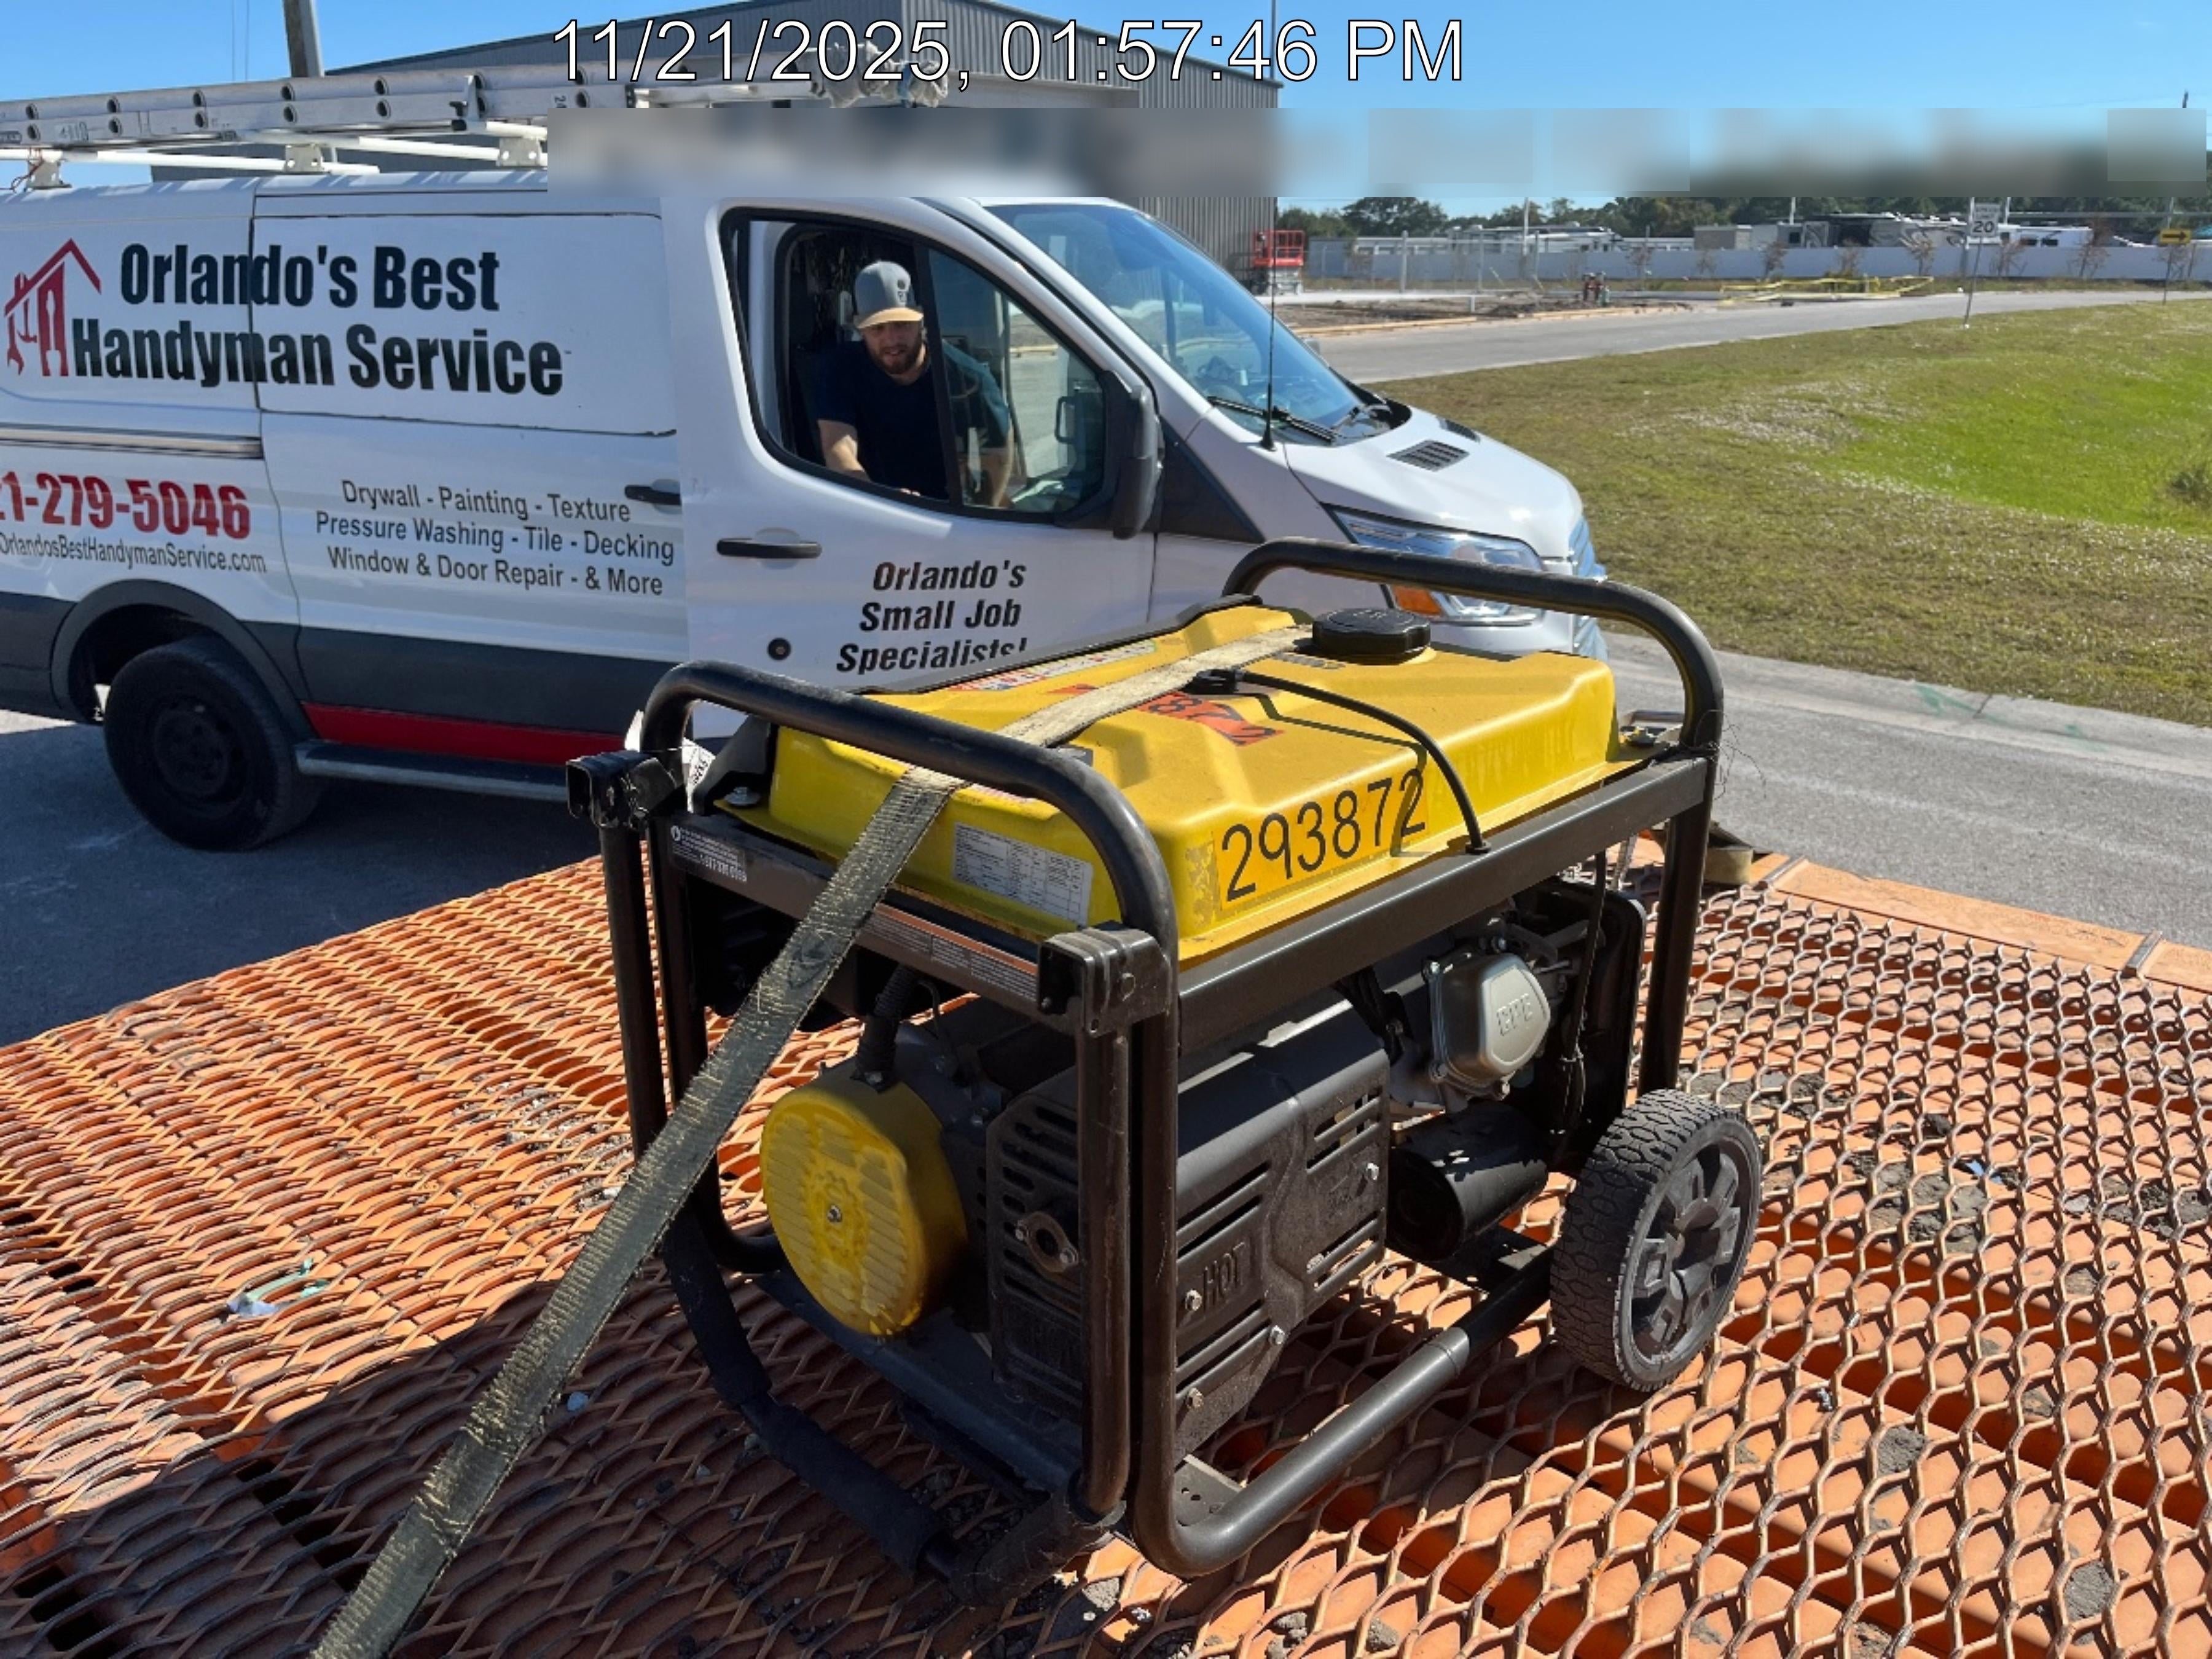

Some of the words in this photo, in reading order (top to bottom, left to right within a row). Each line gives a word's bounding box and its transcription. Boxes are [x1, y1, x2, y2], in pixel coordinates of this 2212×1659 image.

[1972, 221, 1995, 233] 20
[121, 243, 358, 308] Orlando's
[374, 246, 500, 312] Best
[73, 319, 335, 388] Handyman
[346, 323, 563, 396] Service
[0, 471, 251, 539] 1-279-5046
[342, 480, 421, 510] Drywall
[439, 486, 528, 520] Painting
[547, 493, 631, 522] Texture
[316, 510, 407, 541] Pressure
[413, 517, 504, 554] Washing
[524, 525, 563, 552] Tile
[584, 530, 674, 567] Decking
[327, 545, 409, 575] Window
[416, 552, 432, 576] &
[437, 554, 488, 581] Door
[495, 559, 564, 590] Repair
[586, 565, 601, 590] &
[607, 567, 663, 595] More
[873, 560, 1027, 590] Orlando's
[859, 600, 955, 631] Small
[965, 598, 1022, 628] Job
[1222, 768, 1426, 902] 293872
[1202, 1241, 1245, 1311] HOT
